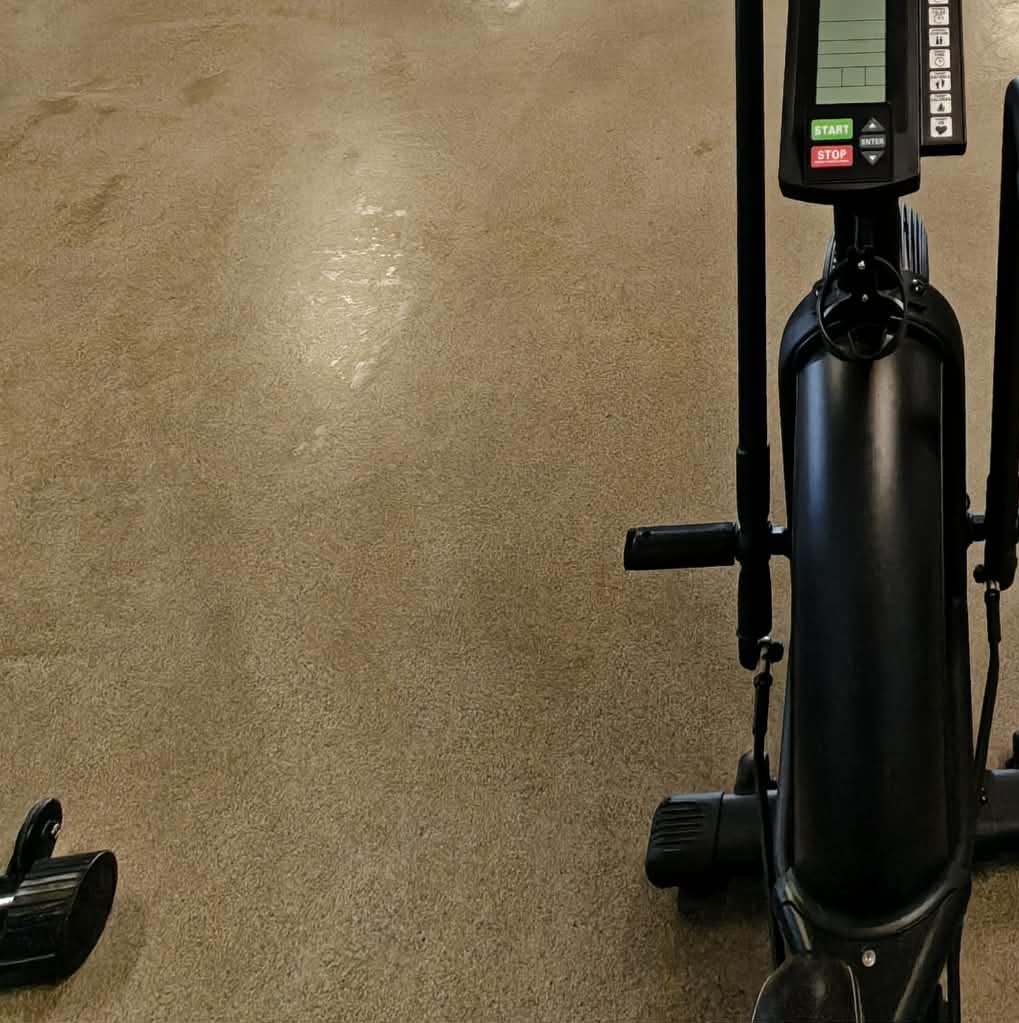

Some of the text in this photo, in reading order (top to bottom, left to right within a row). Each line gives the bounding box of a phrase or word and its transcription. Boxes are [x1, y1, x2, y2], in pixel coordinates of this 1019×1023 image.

[814, 124, 849, 136] START
[861, 137, 885, 146] ENTER
[817, 149, 847, 160] STOP
